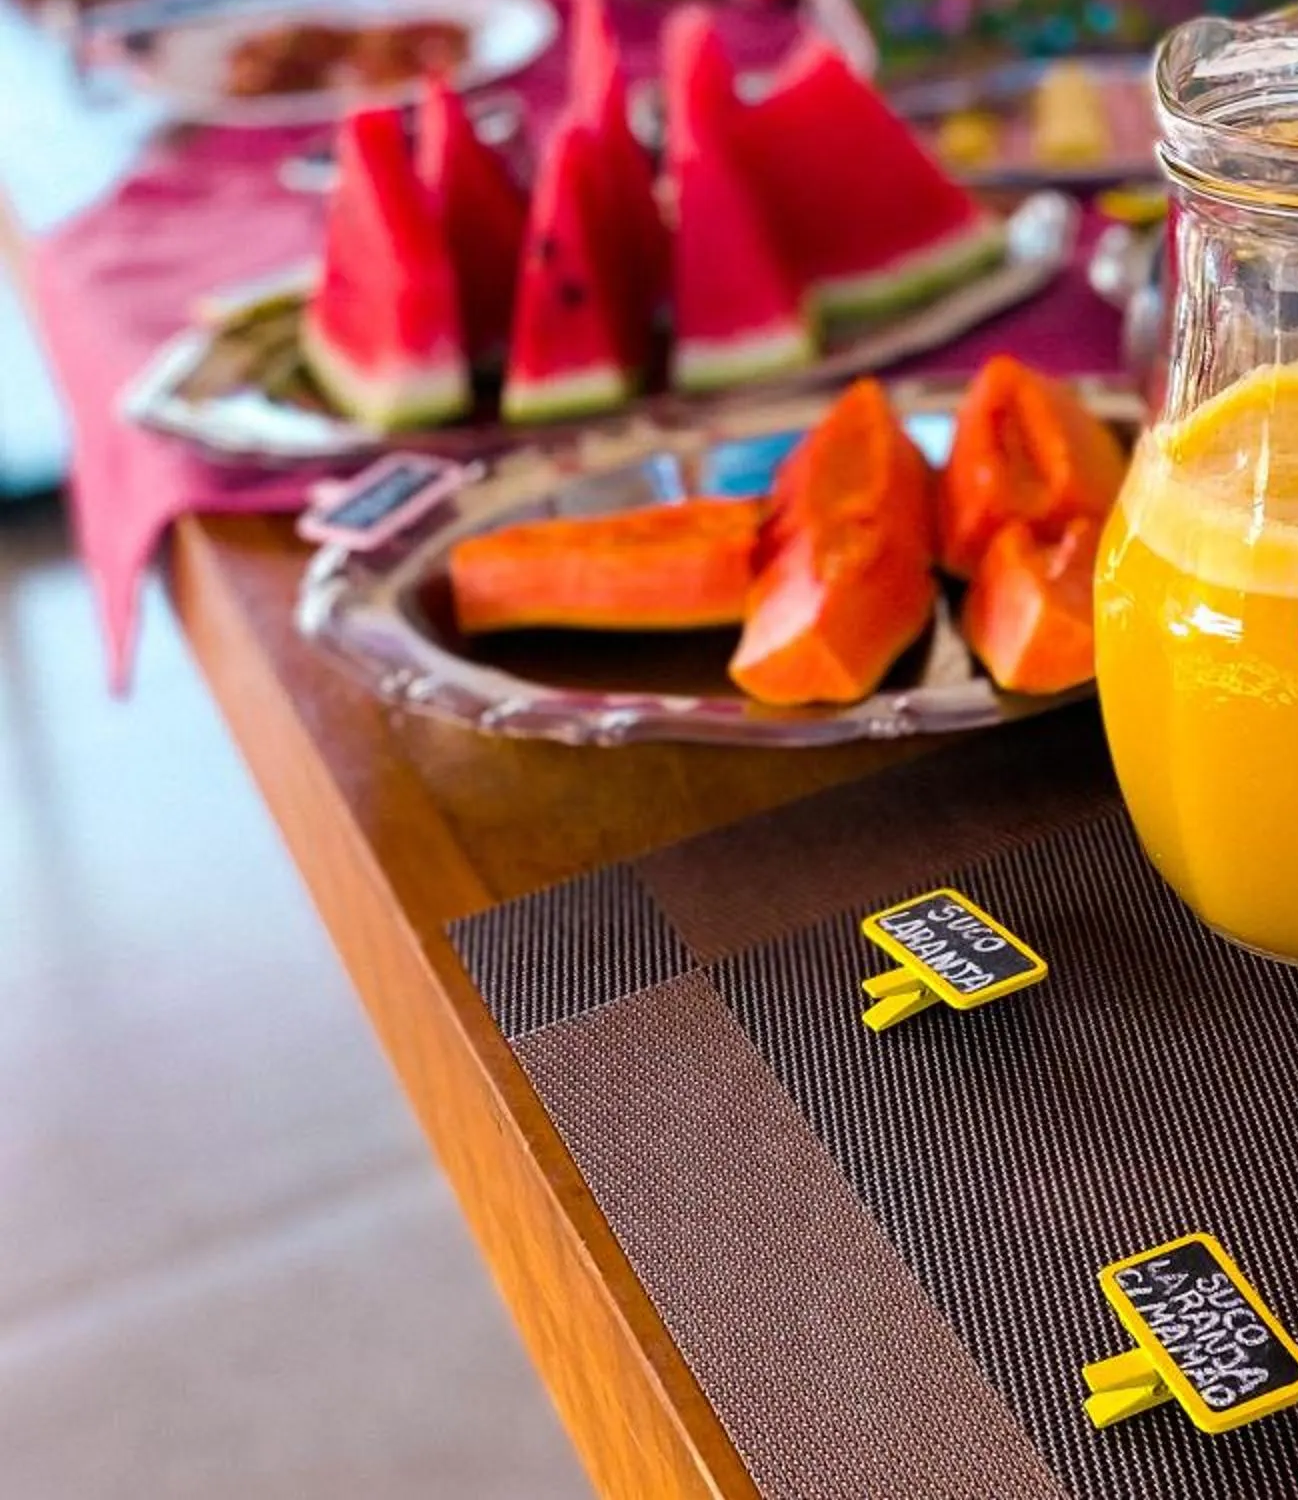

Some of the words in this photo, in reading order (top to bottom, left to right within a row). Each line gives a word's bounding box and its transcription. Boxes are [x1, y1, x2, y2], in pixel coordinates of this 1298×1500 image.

[879, 911, 995, 993] LARANJA
[927, 903, 1006, 953] SUCO
[1147, 1258, 1270, 1394] LARANJA
[1195, 1273, 1269, 1347] SUCO
